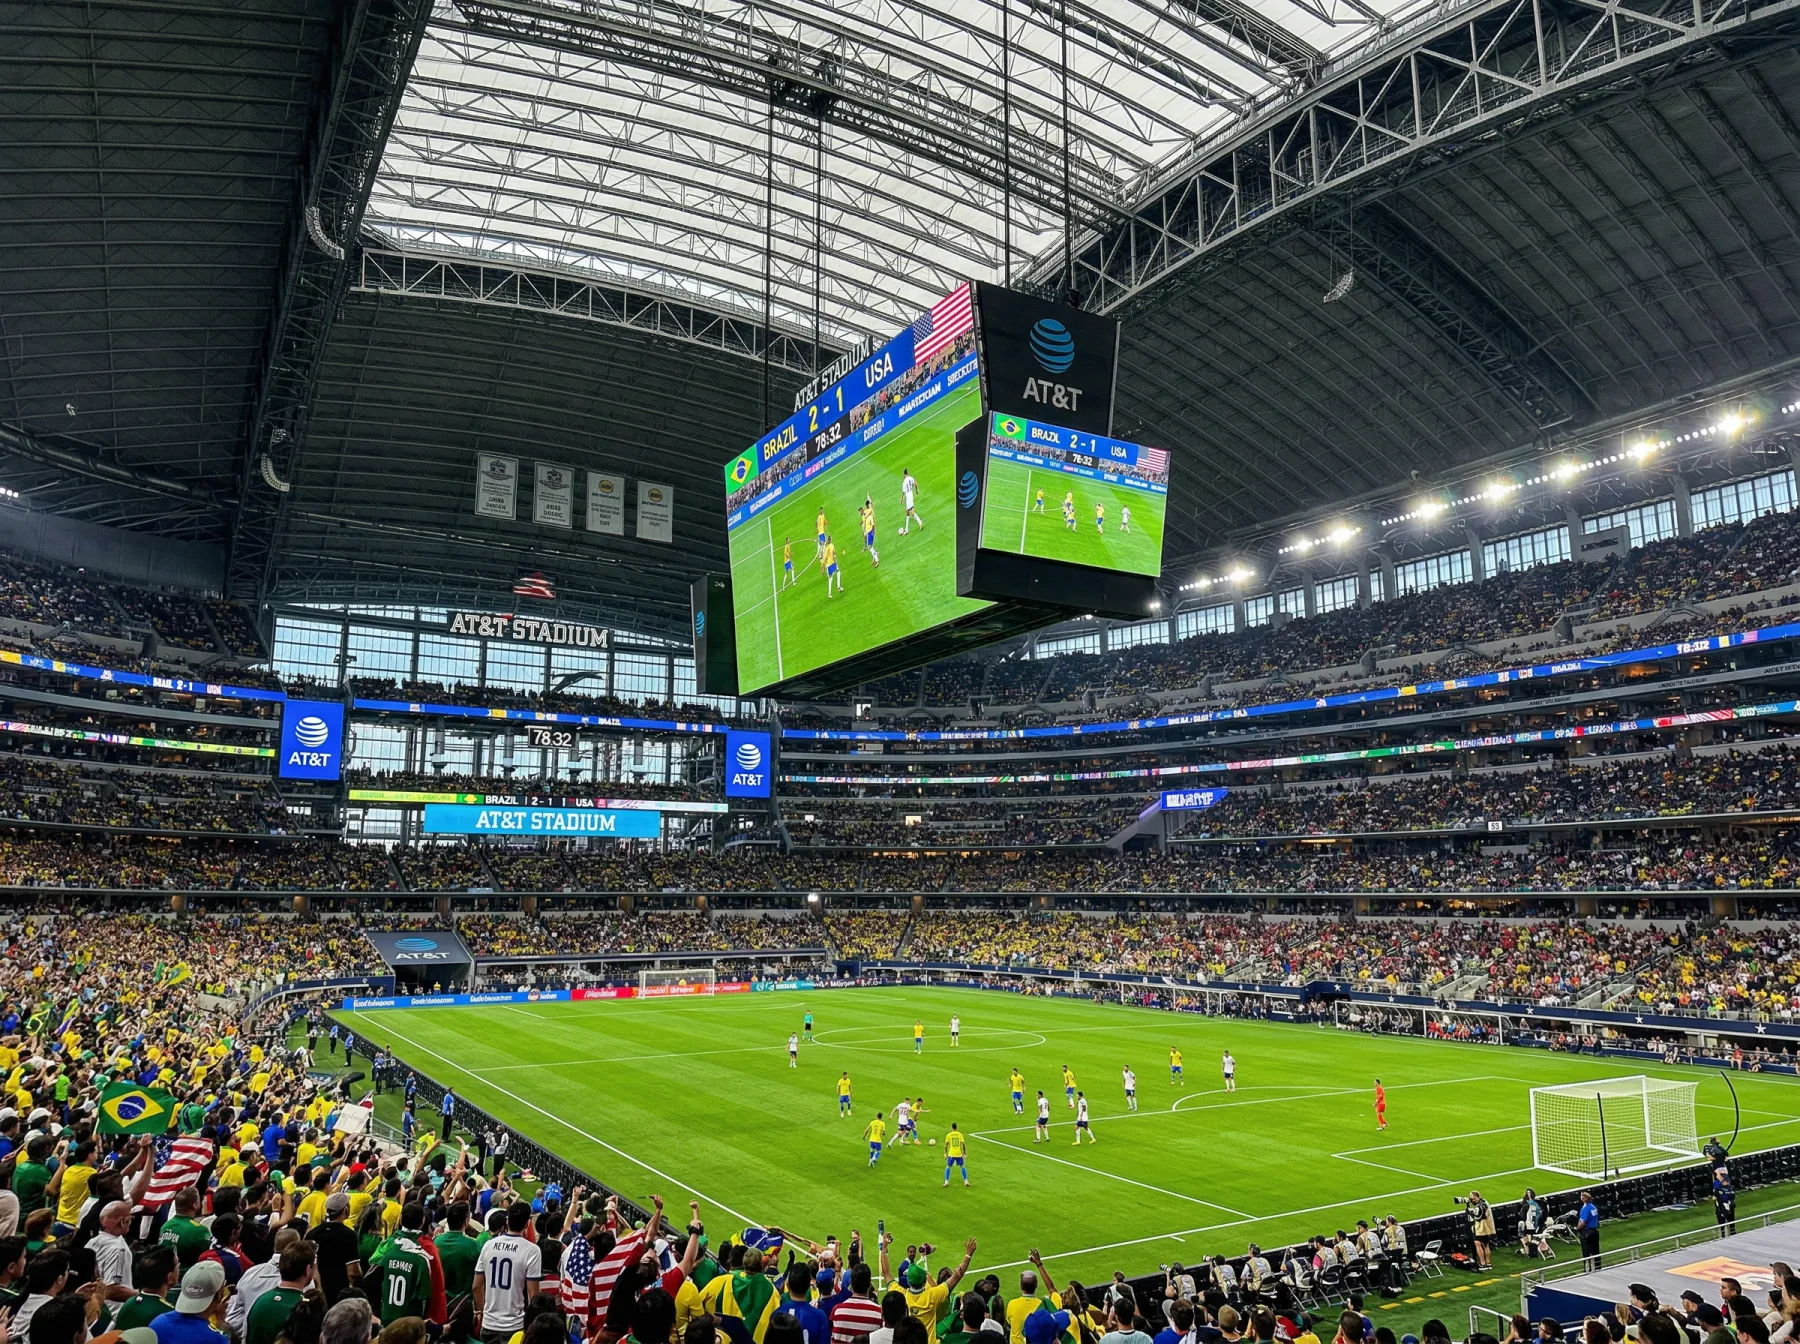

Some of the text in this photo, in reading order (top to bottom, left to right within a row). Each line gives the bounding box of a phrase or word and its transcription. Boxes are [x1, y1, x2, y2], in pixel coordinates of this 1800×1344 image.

[794, 339, 870, 412] AT&T STADIUM
[865, 352, 893, 388] USA
[1023, 377, 1082, 411] AT&T
[763, 424, 798, 461] BRAZIL
[808, 406, 818, 433] 2
[836, 386, 844, 412] 1
[815, 422, 842, 452] 78:32
[1070, 434, 1078, 449] 2
[1091, 439, 1096, 453] 1
[1111, 446, 1127, 459] USA
[450, 613, 608, 648] AT&T STADIUM
[288, 752, 331, 767] AT&T
[732, 773, 764, 786] AT&T
[485, 795, 518, 805] BRAZIL
[531, 797, 538, 806] 2
[575, 798, 593, 807] USA
[475, 810, 616, 831] AT&T STADIUM
[395, 952, 450, 960] AT&T
[490, 1256, 512, 1290] 10
[388, 1274, 406, 1306] 10
